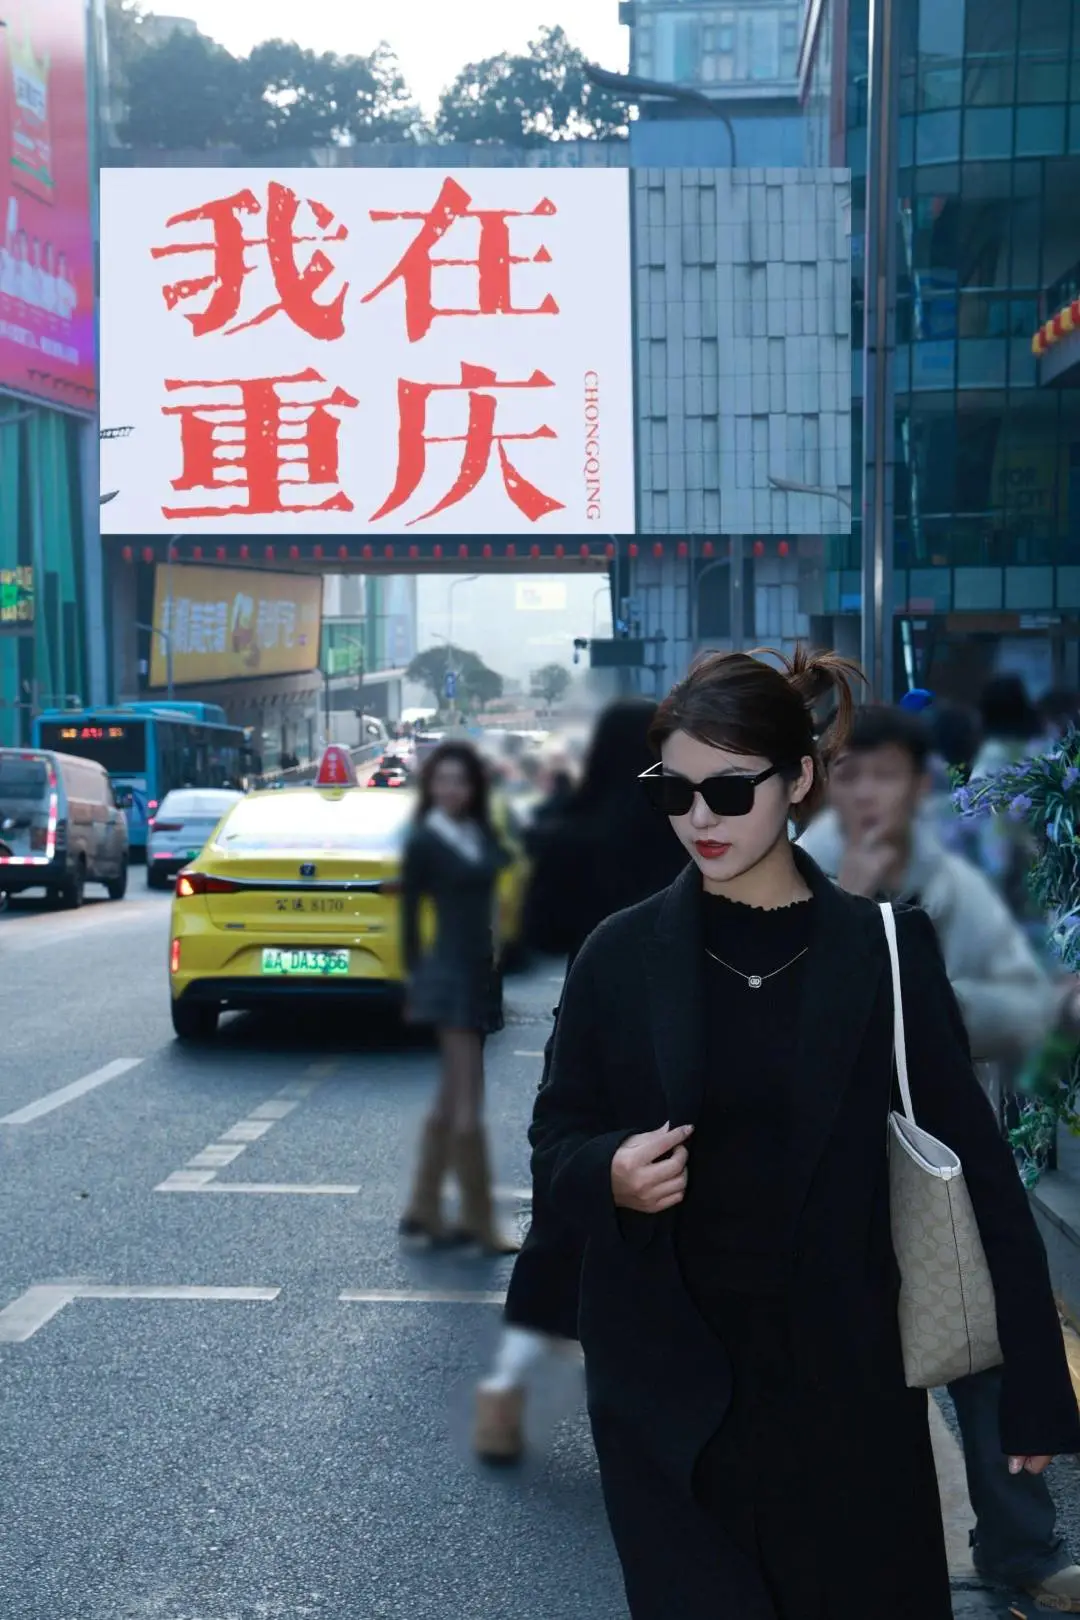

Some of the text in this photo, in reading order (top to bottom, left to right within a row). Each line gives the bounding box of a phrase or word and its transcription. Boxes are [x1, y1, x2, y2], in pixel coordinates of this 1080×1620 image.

[151, 177, 560, 343] 我在
[161, 361, 566, 525] 重庆
[583, 370, 602, 521] CHONGQING
